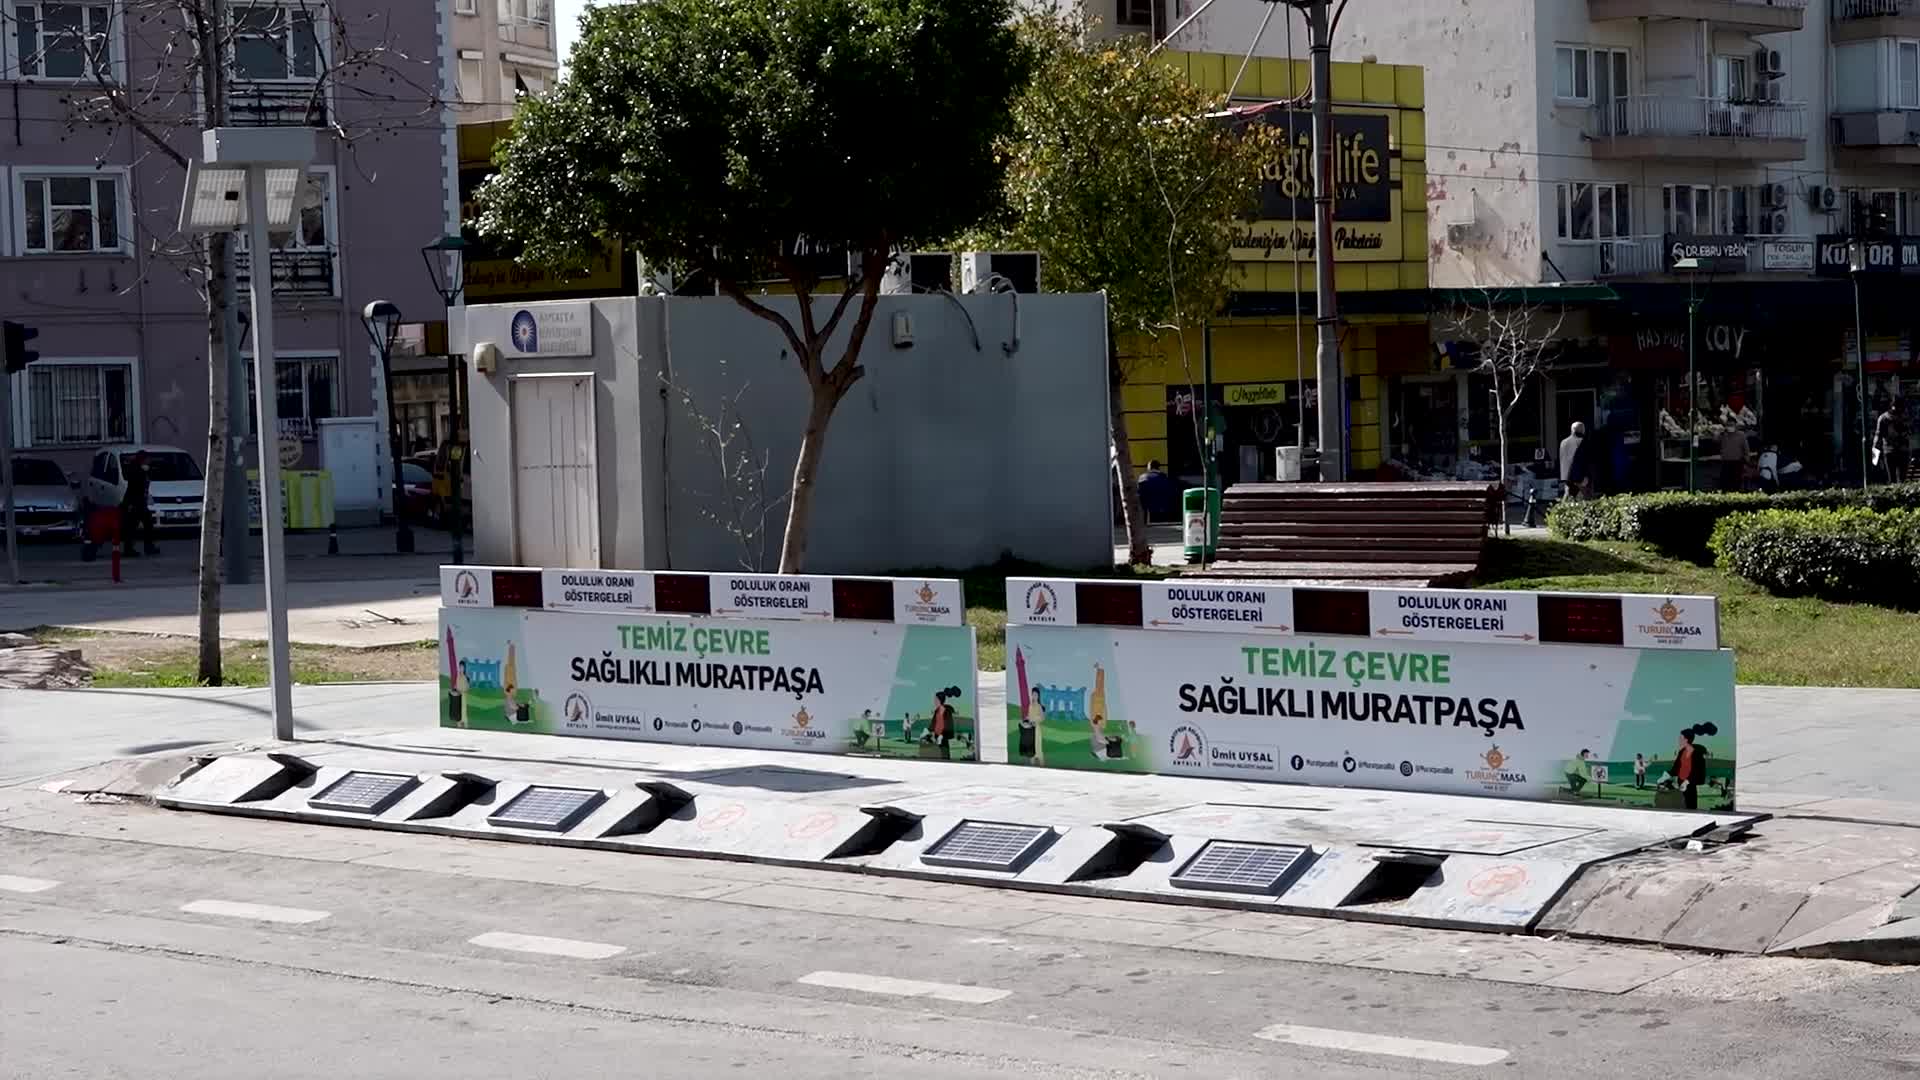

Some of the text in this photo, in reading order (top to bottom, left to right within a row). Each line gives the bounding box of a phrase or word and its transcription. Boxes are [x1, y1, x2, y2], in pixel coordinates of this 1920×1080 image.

[1257, 132, 1380, 197] agi life
[1302, 186, 1357, 200] MLYA
[561, 575, 634, 588] DOLULUK ORANI
[730, 579, 810, 593] DOLULUK ORANI
[564, 591, 633, 604] GÖSTERGELERİ
[734, 594, 808, 609] GÖSTERGELERİ
[1168, 588, 1266, 604] DOLULUK ORANI
[1398, 596, 1507, 611] DOLULUK ORANI
[1171, 604, 1263, 622] GÖSTERGELERİ
[1402, 612, 1504, 631] GÖSTERGELERİ
[617, 620, 771, 659] TEMİZ ÇEVRE
[1241, 641, 1450, 687] TEMİZ ÇEVRE
[571, 650, 825, 700] SAĞLIKLI MURATPAŞA
[1178, 676, 1525, 738] SAĞLIKLI MURATPAŞA
[615, 714, 641, 725] UYSAL
[1238, 751, 1273, 762] UYSAL
